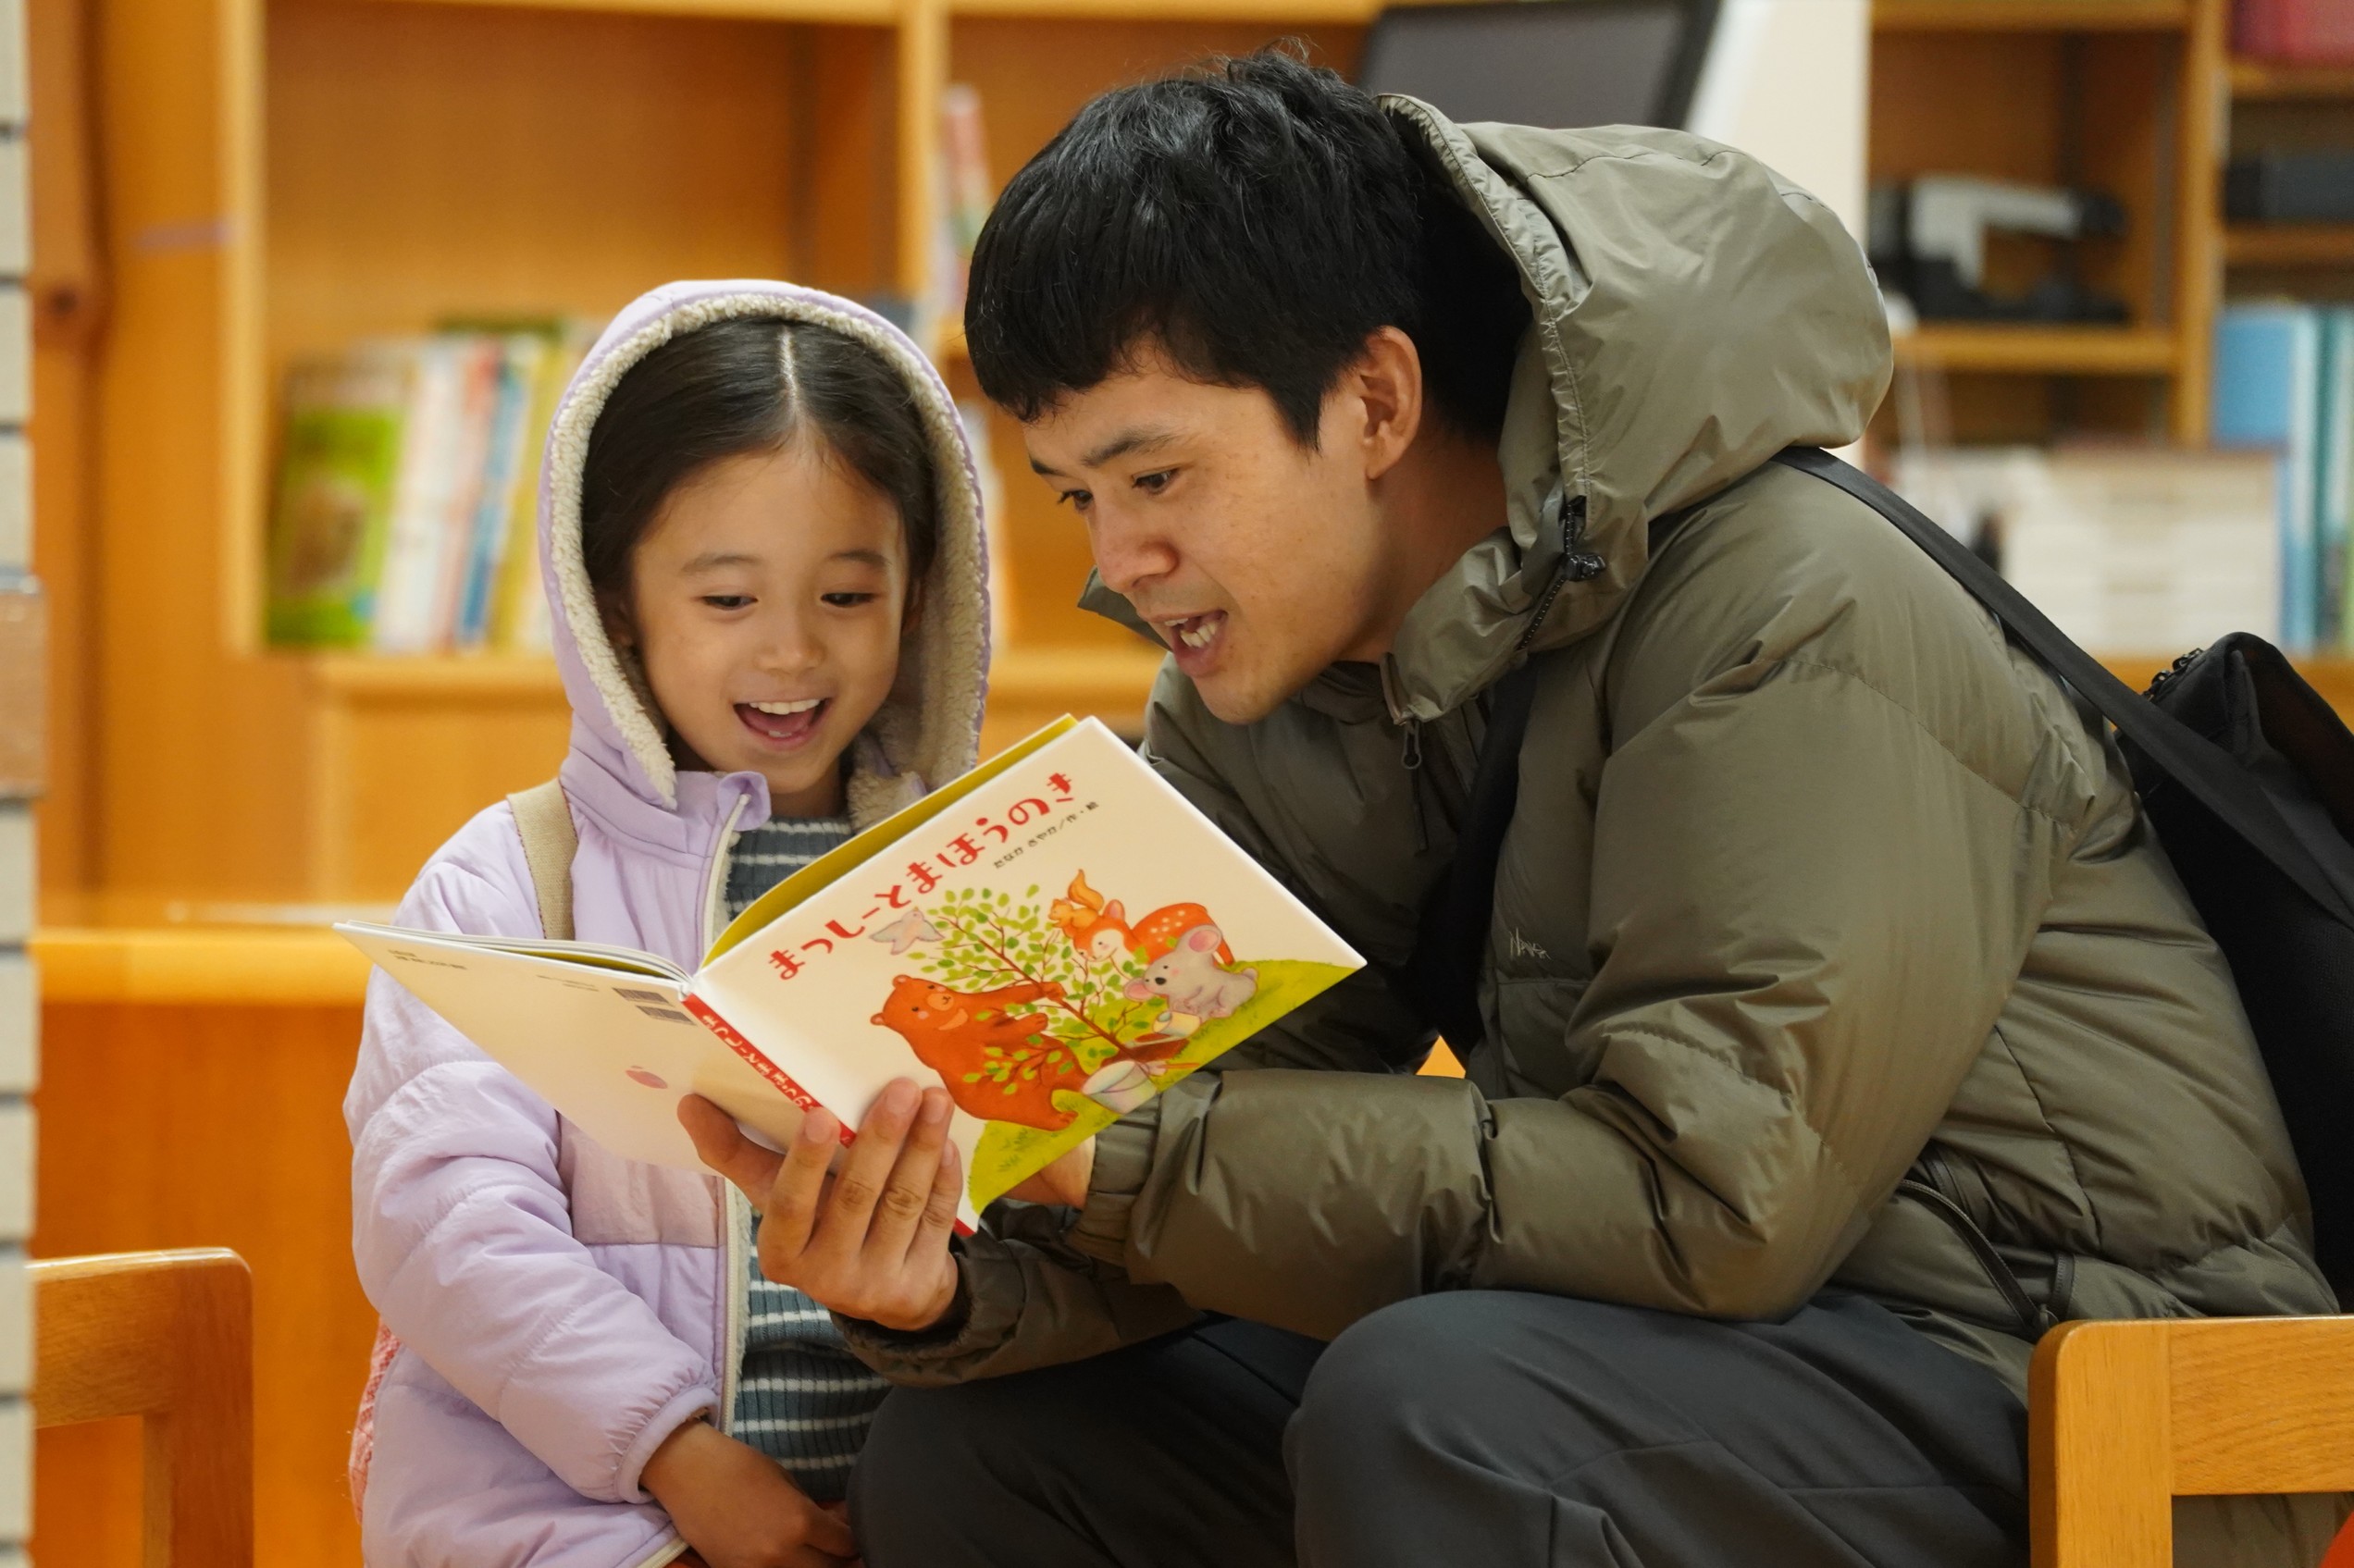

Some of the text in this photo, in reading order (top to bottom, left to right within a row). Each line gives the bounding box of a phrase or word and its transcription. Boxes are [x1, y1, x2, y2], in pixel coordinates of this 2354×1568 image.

[701, 1015, 815, 1110] まっしーとまほうの
